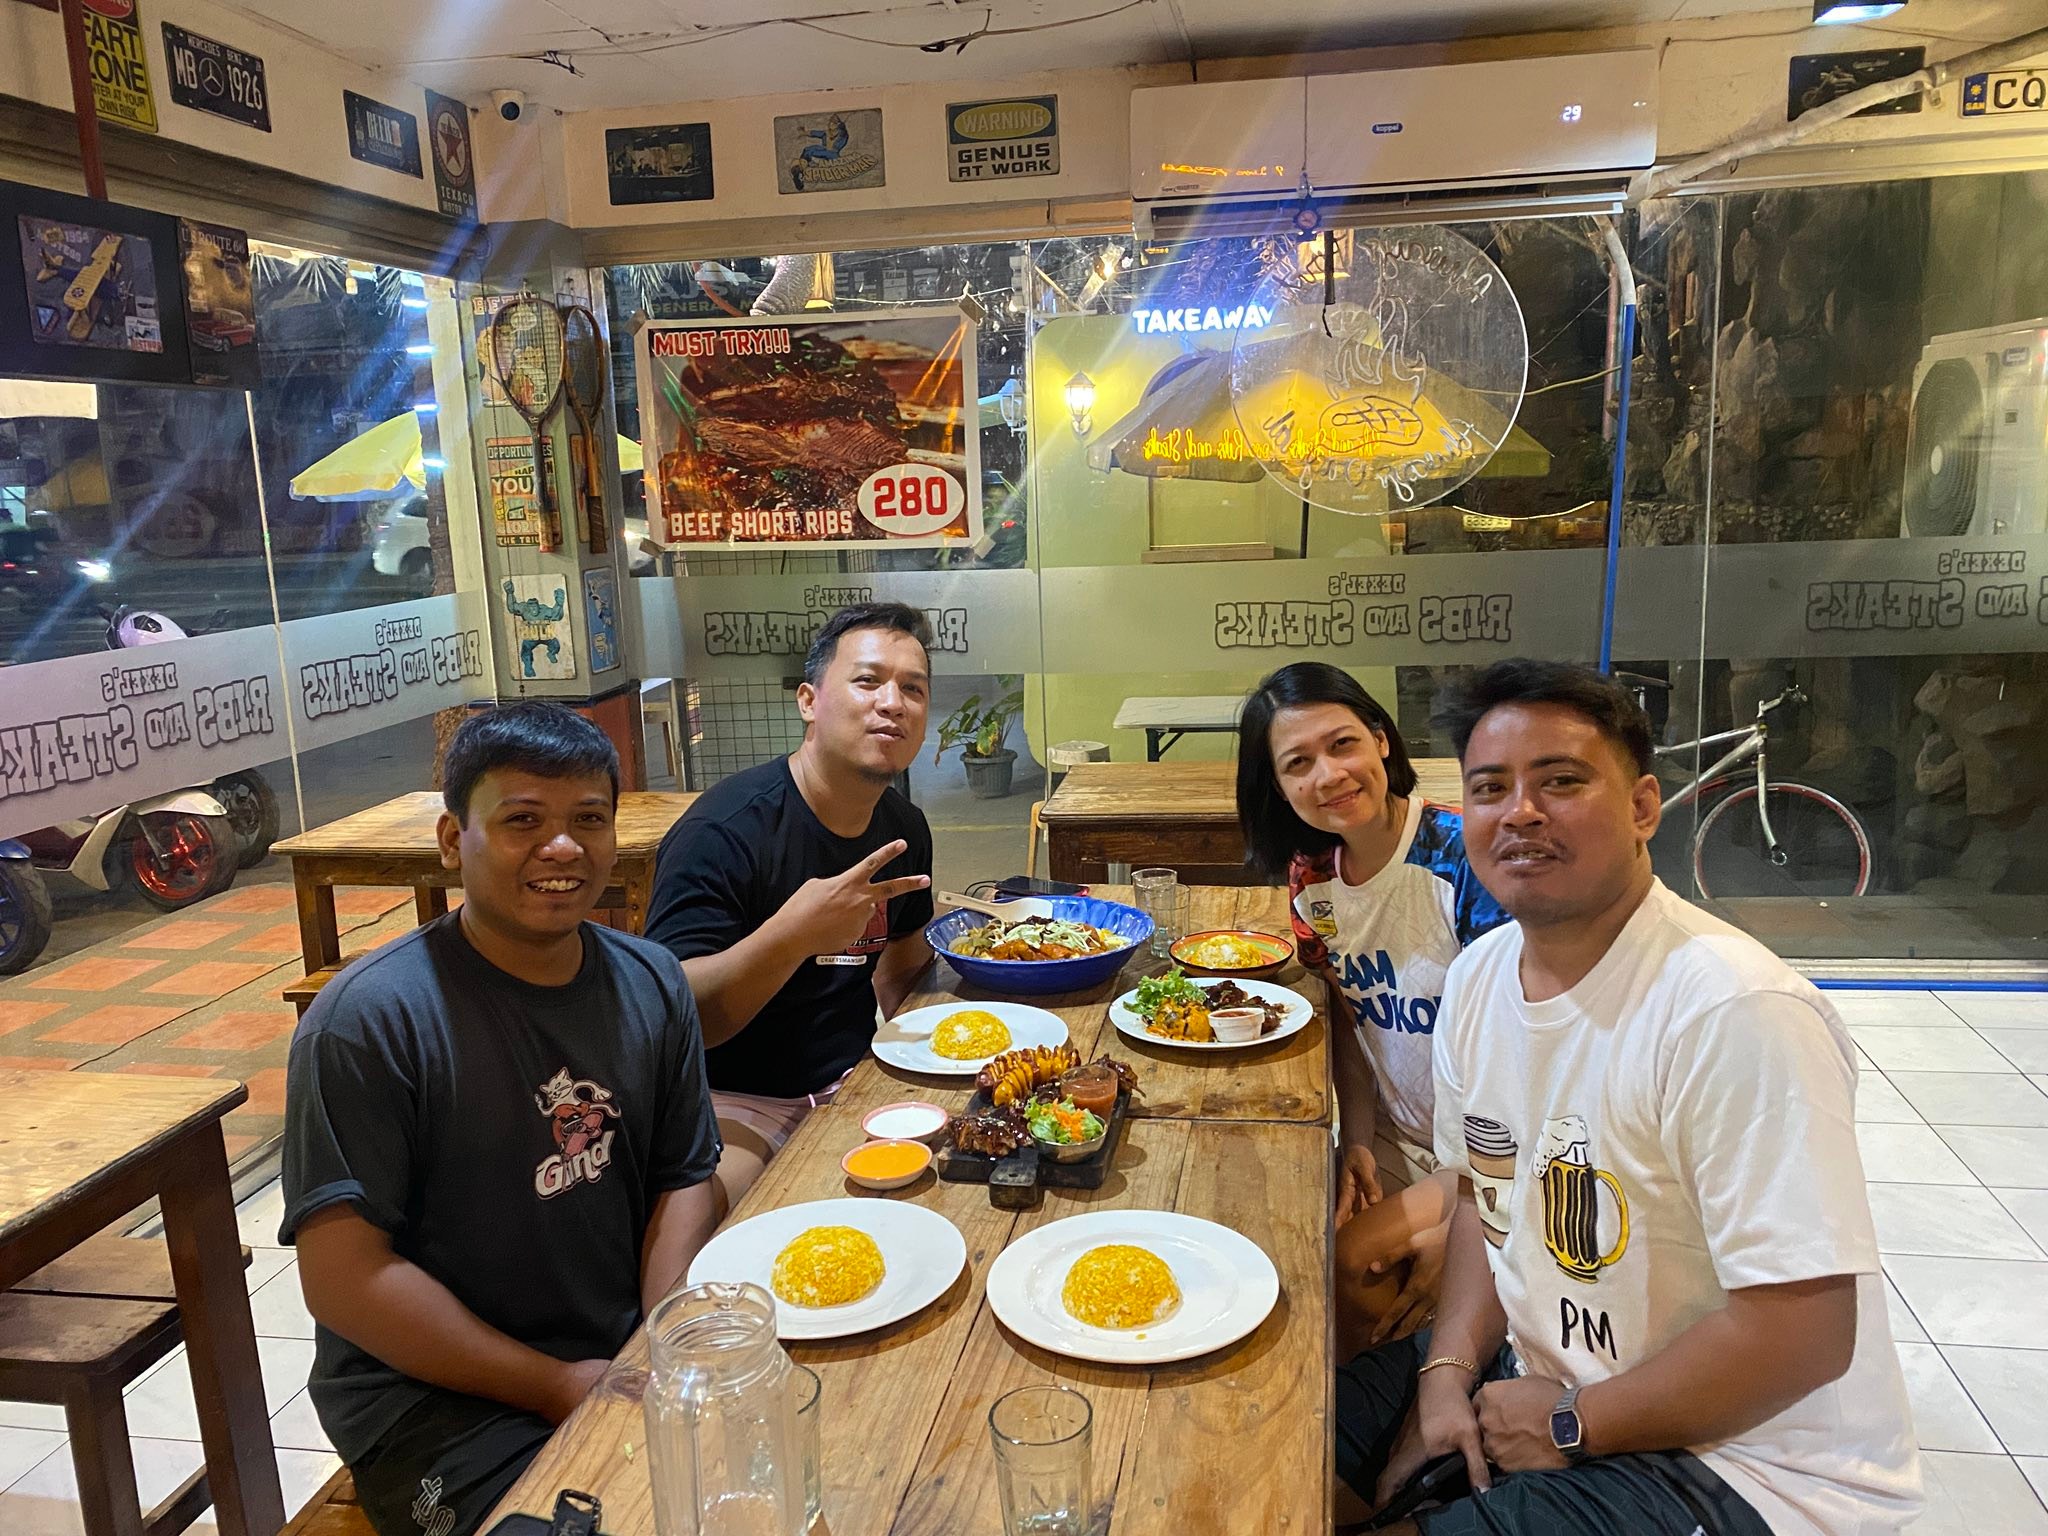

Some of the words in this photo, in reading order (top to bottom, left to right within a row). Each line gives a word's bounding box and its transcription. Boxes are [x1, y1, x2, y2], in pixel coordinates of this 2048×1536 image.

[173, 46, 198, 90] MB
[227, 65, 262, 110] 1926
[99, 97, 118, 113] OWN
[113, 89, 122, 101] AT
[123, 92, 145, 108] YOUR
[961, 107, 1046, 133] WARNING
[1562, 105, 1582, 121] 29
[1376, 123, 1399, 133] koppel
[957, 143, 1050, 164] GENIUS
[958, 165, 988, 177] AT
[991, 159, 1052, 175] WORK
[441, 185, 474, 206] TEXACO
[198, 231, 232, 252] ROUTE
[1132, 305, 1275, 334] TAKEAWAY
[653, 330, 718, 357] MUST
[720, 328, 791, 356] TRY!!!
[487, 445, 552, 459] OPPORTUNES
[491, 477, 532, 494] YOU
[873, 476, 948, 518] 280
[671, 511, 722, 537] BEEF
[731, 511, 798, 537] SHORT
[807, 510, 852, 536] RIBS
[1560, 1296, 1618, 1360] PM
